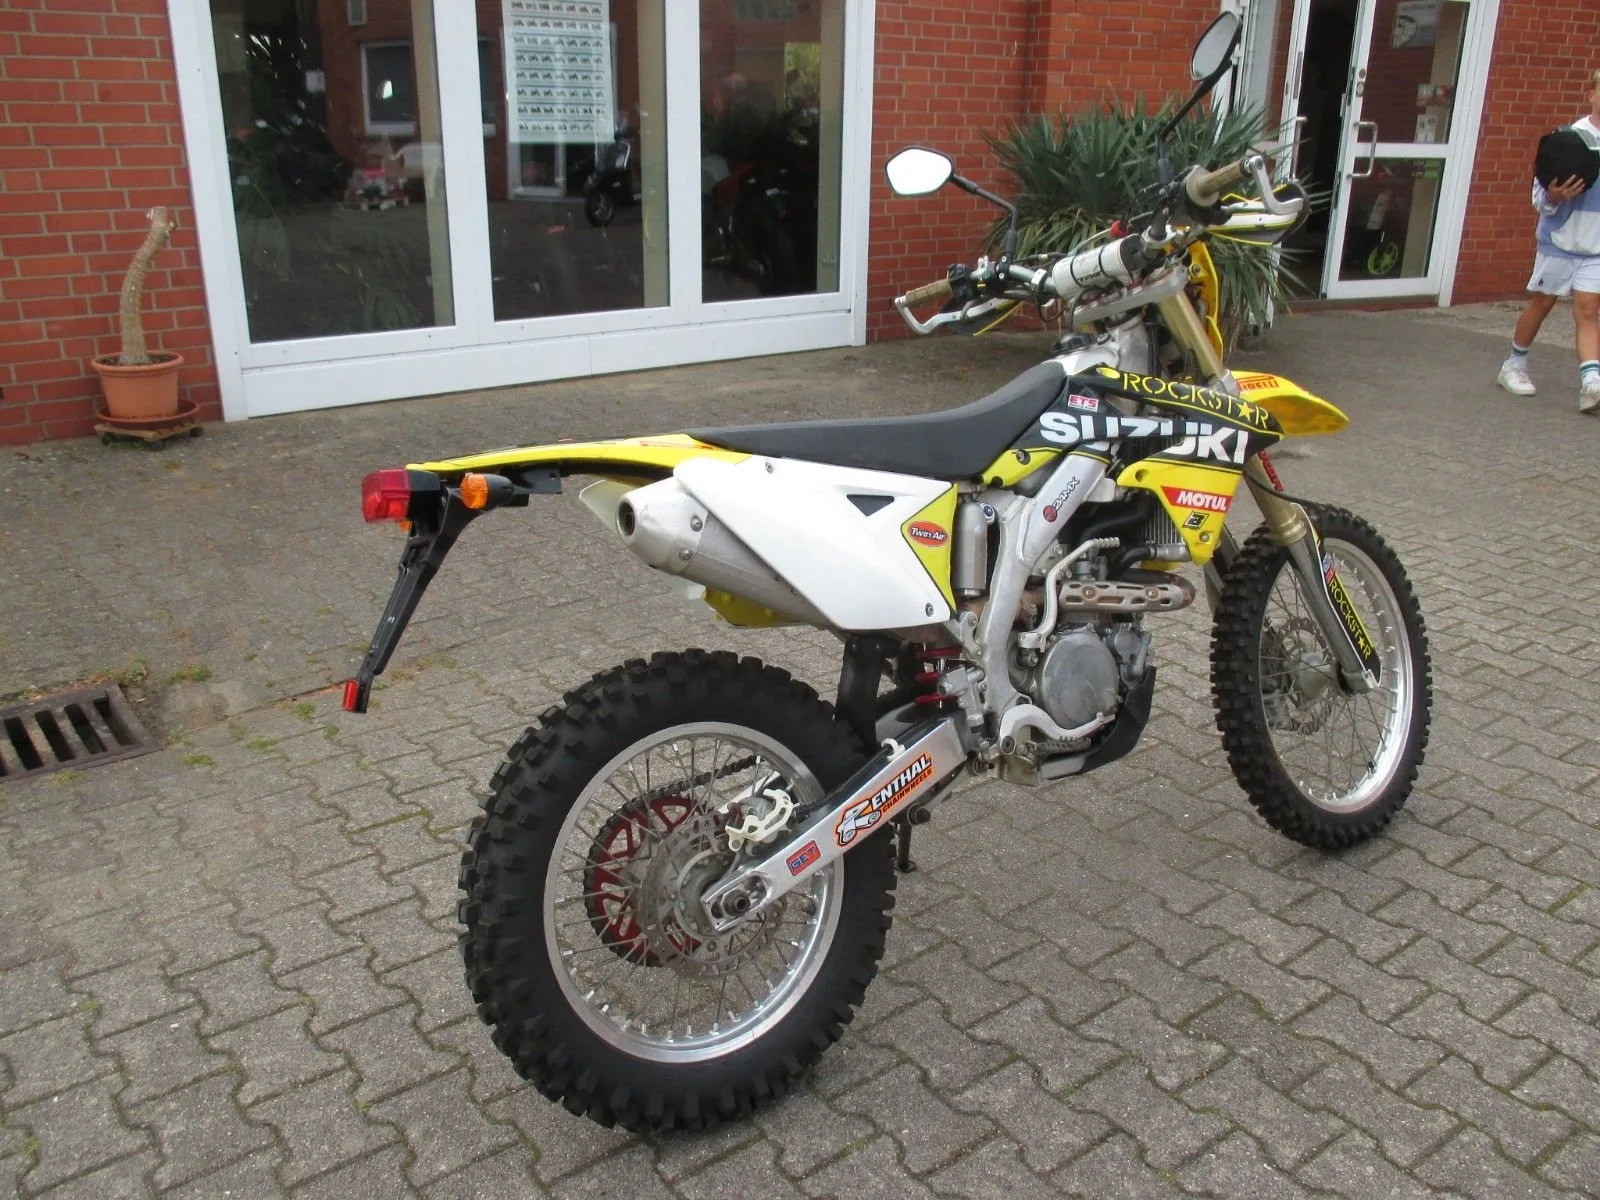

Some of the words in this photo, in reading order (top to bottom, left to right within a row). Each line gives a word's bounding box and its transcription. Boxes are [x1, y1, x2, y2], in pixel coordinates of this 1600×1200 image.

[1070, 395, 1097, 408] ETS
[1040, 411, 1249, 465] SUZUKI
[1176, 490, 1227, 511] MOTUL
[911, 527, 932, 539] Twin
[932, 531, 946, 541] Air
[882, 767, 933, 813] CHAINWHEELS
[791, 845, 816, 869] GET
